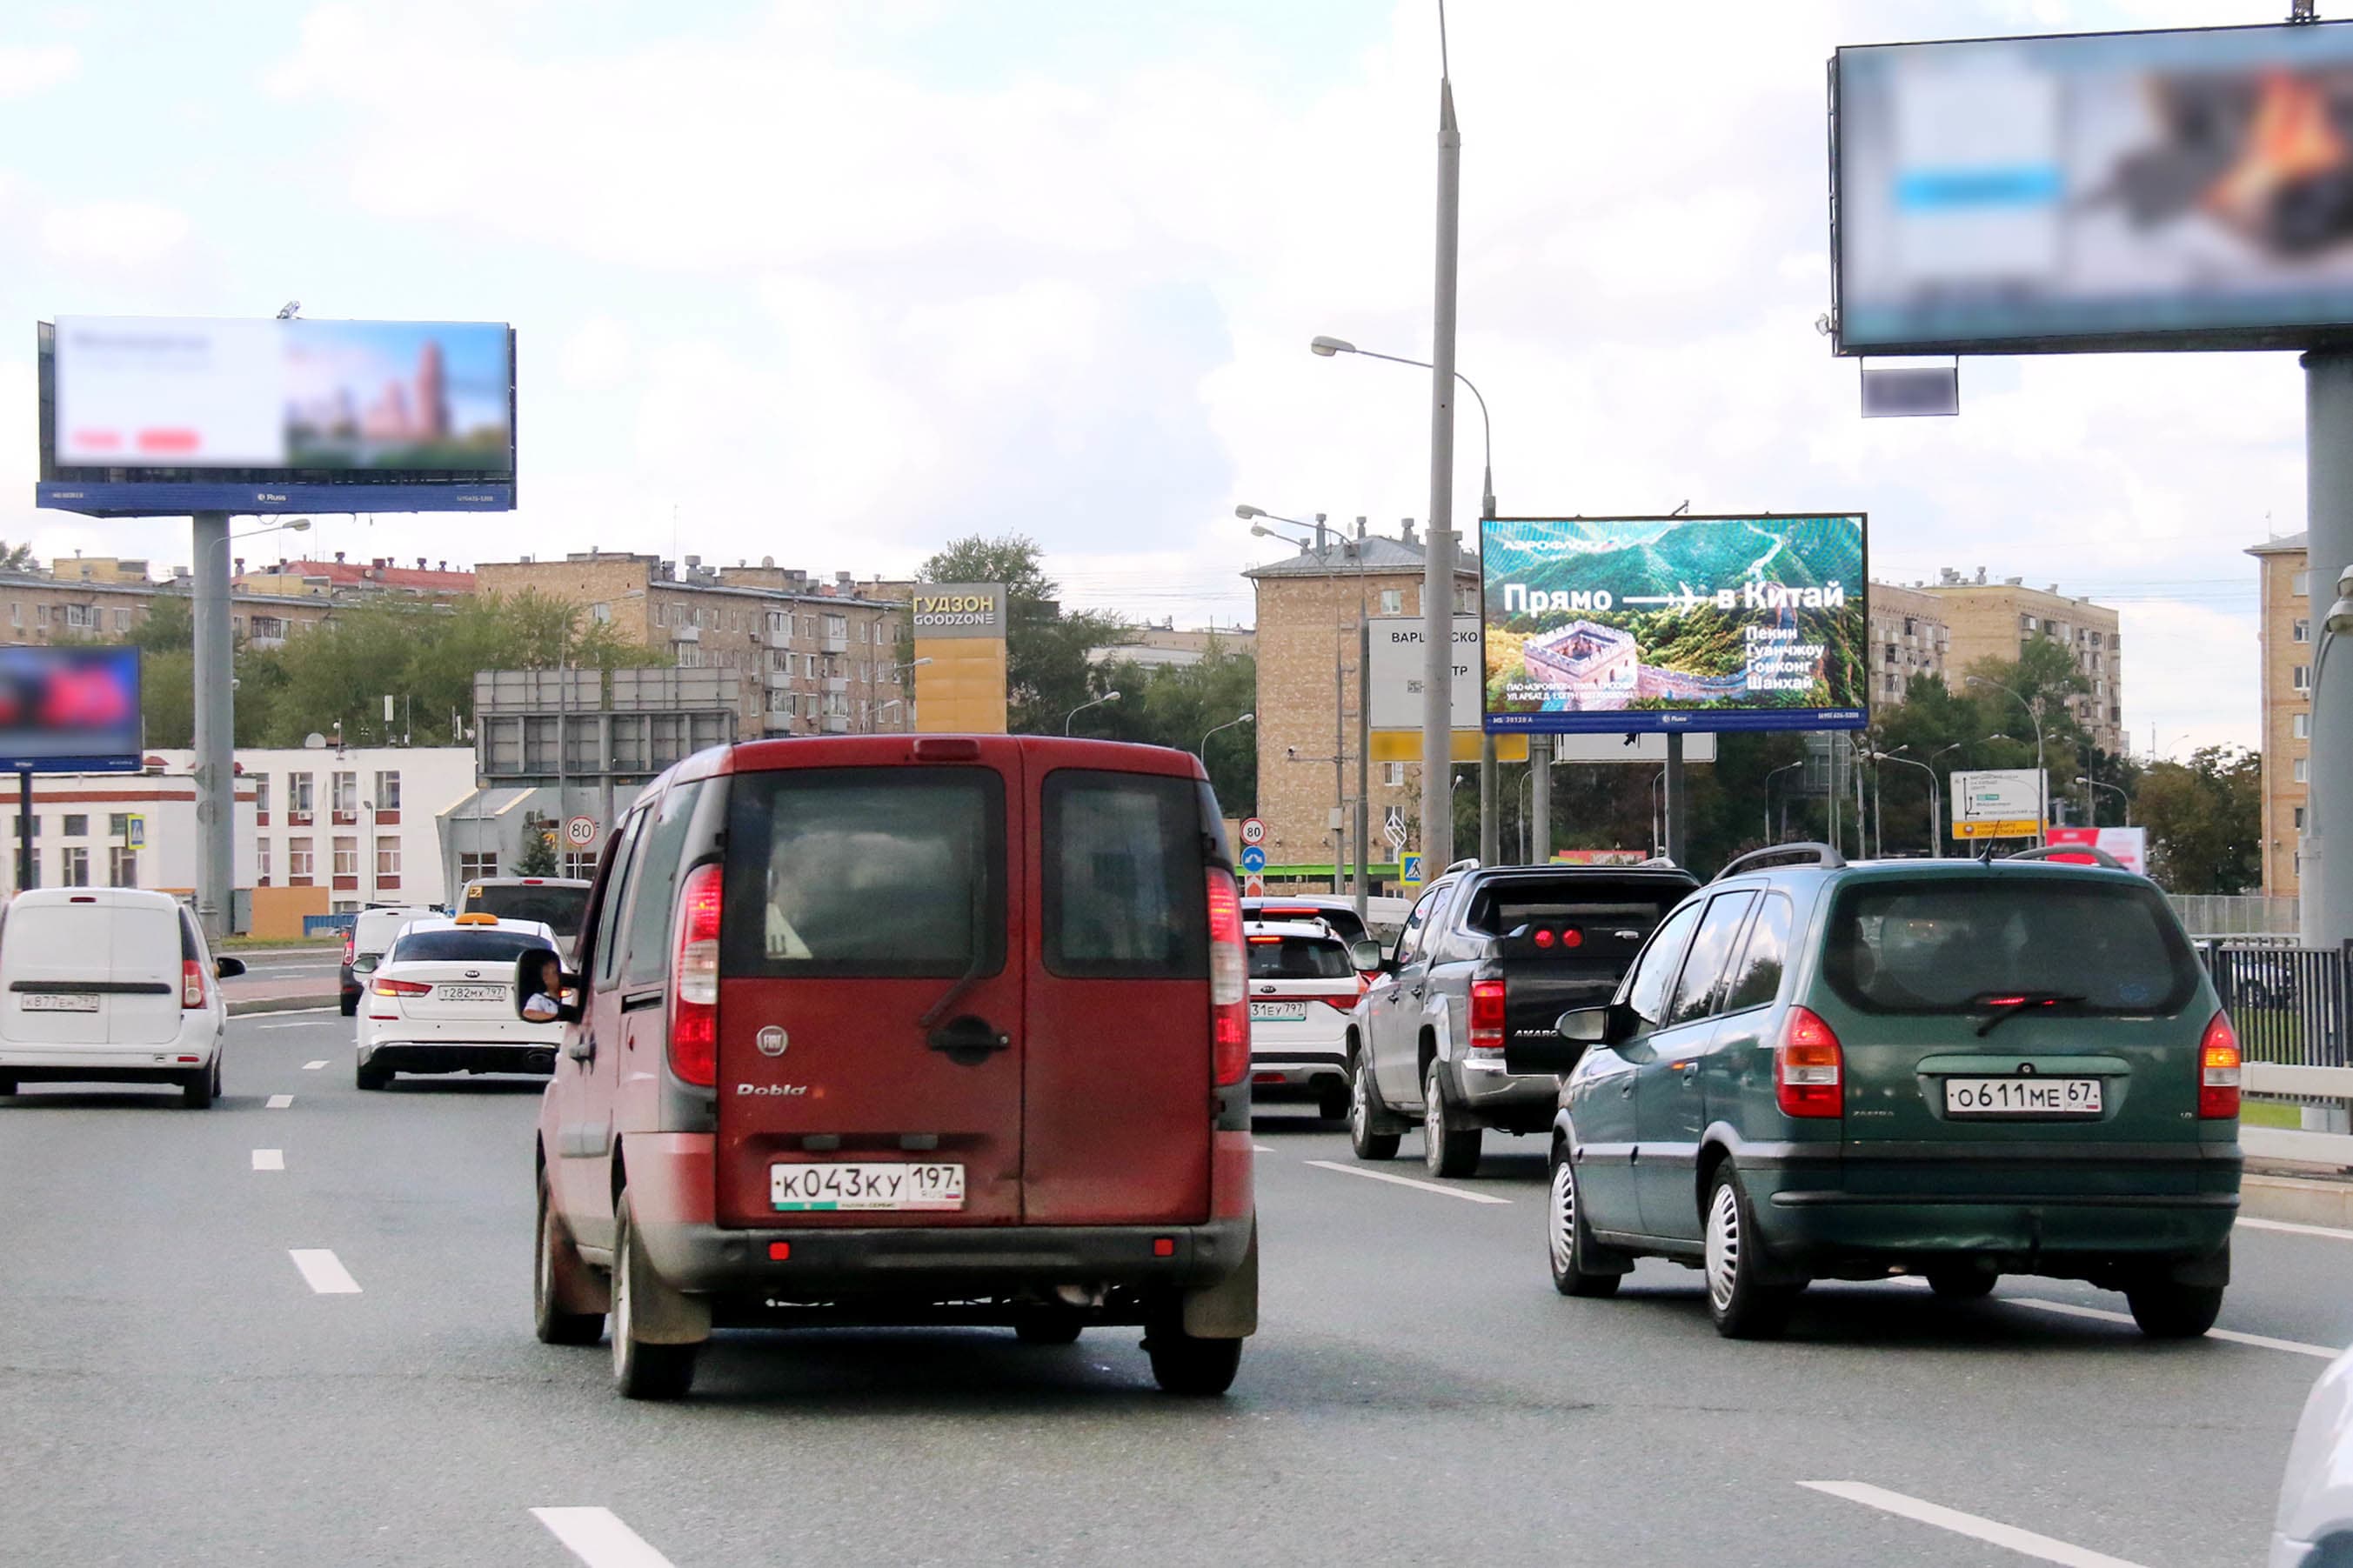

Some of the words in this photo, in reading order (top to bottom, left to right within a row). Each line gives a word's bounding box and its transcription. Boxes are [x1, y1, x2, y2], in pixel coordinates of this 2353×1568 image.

[1504, 584, 1613, 618] Прямо
[1717, 589, 1736, 609] в
[1744, 580, 1845, 609] Китай
[912, 596, 994, 613] ГУДЗОН
[913, 614, 996, 625] GOODZONE
[1747, 626, 1798, 640] Пекин
[1747, 644, 1825, 659] Гуанчжоу
[1747, 660, 1813, 673] Гонконг
[1747, 676, 1814, 690] Шанхай
[572, 824, 592, 837] 80
[1247, 827, 1261, 837] 80
[444, 987, 485, 998] Т282МХ
[1252, 1004, 1282, 1016] 31ЕУ
[1284, 1004, 1303, 1013] 797
[1958, 1083, 2060, 1107] О611МЕ
[2068, 1082, 2091, 1101] 67
[784, 1168, 902, 1198] К043КУ
[912, 1166, 956, 1189] 197
